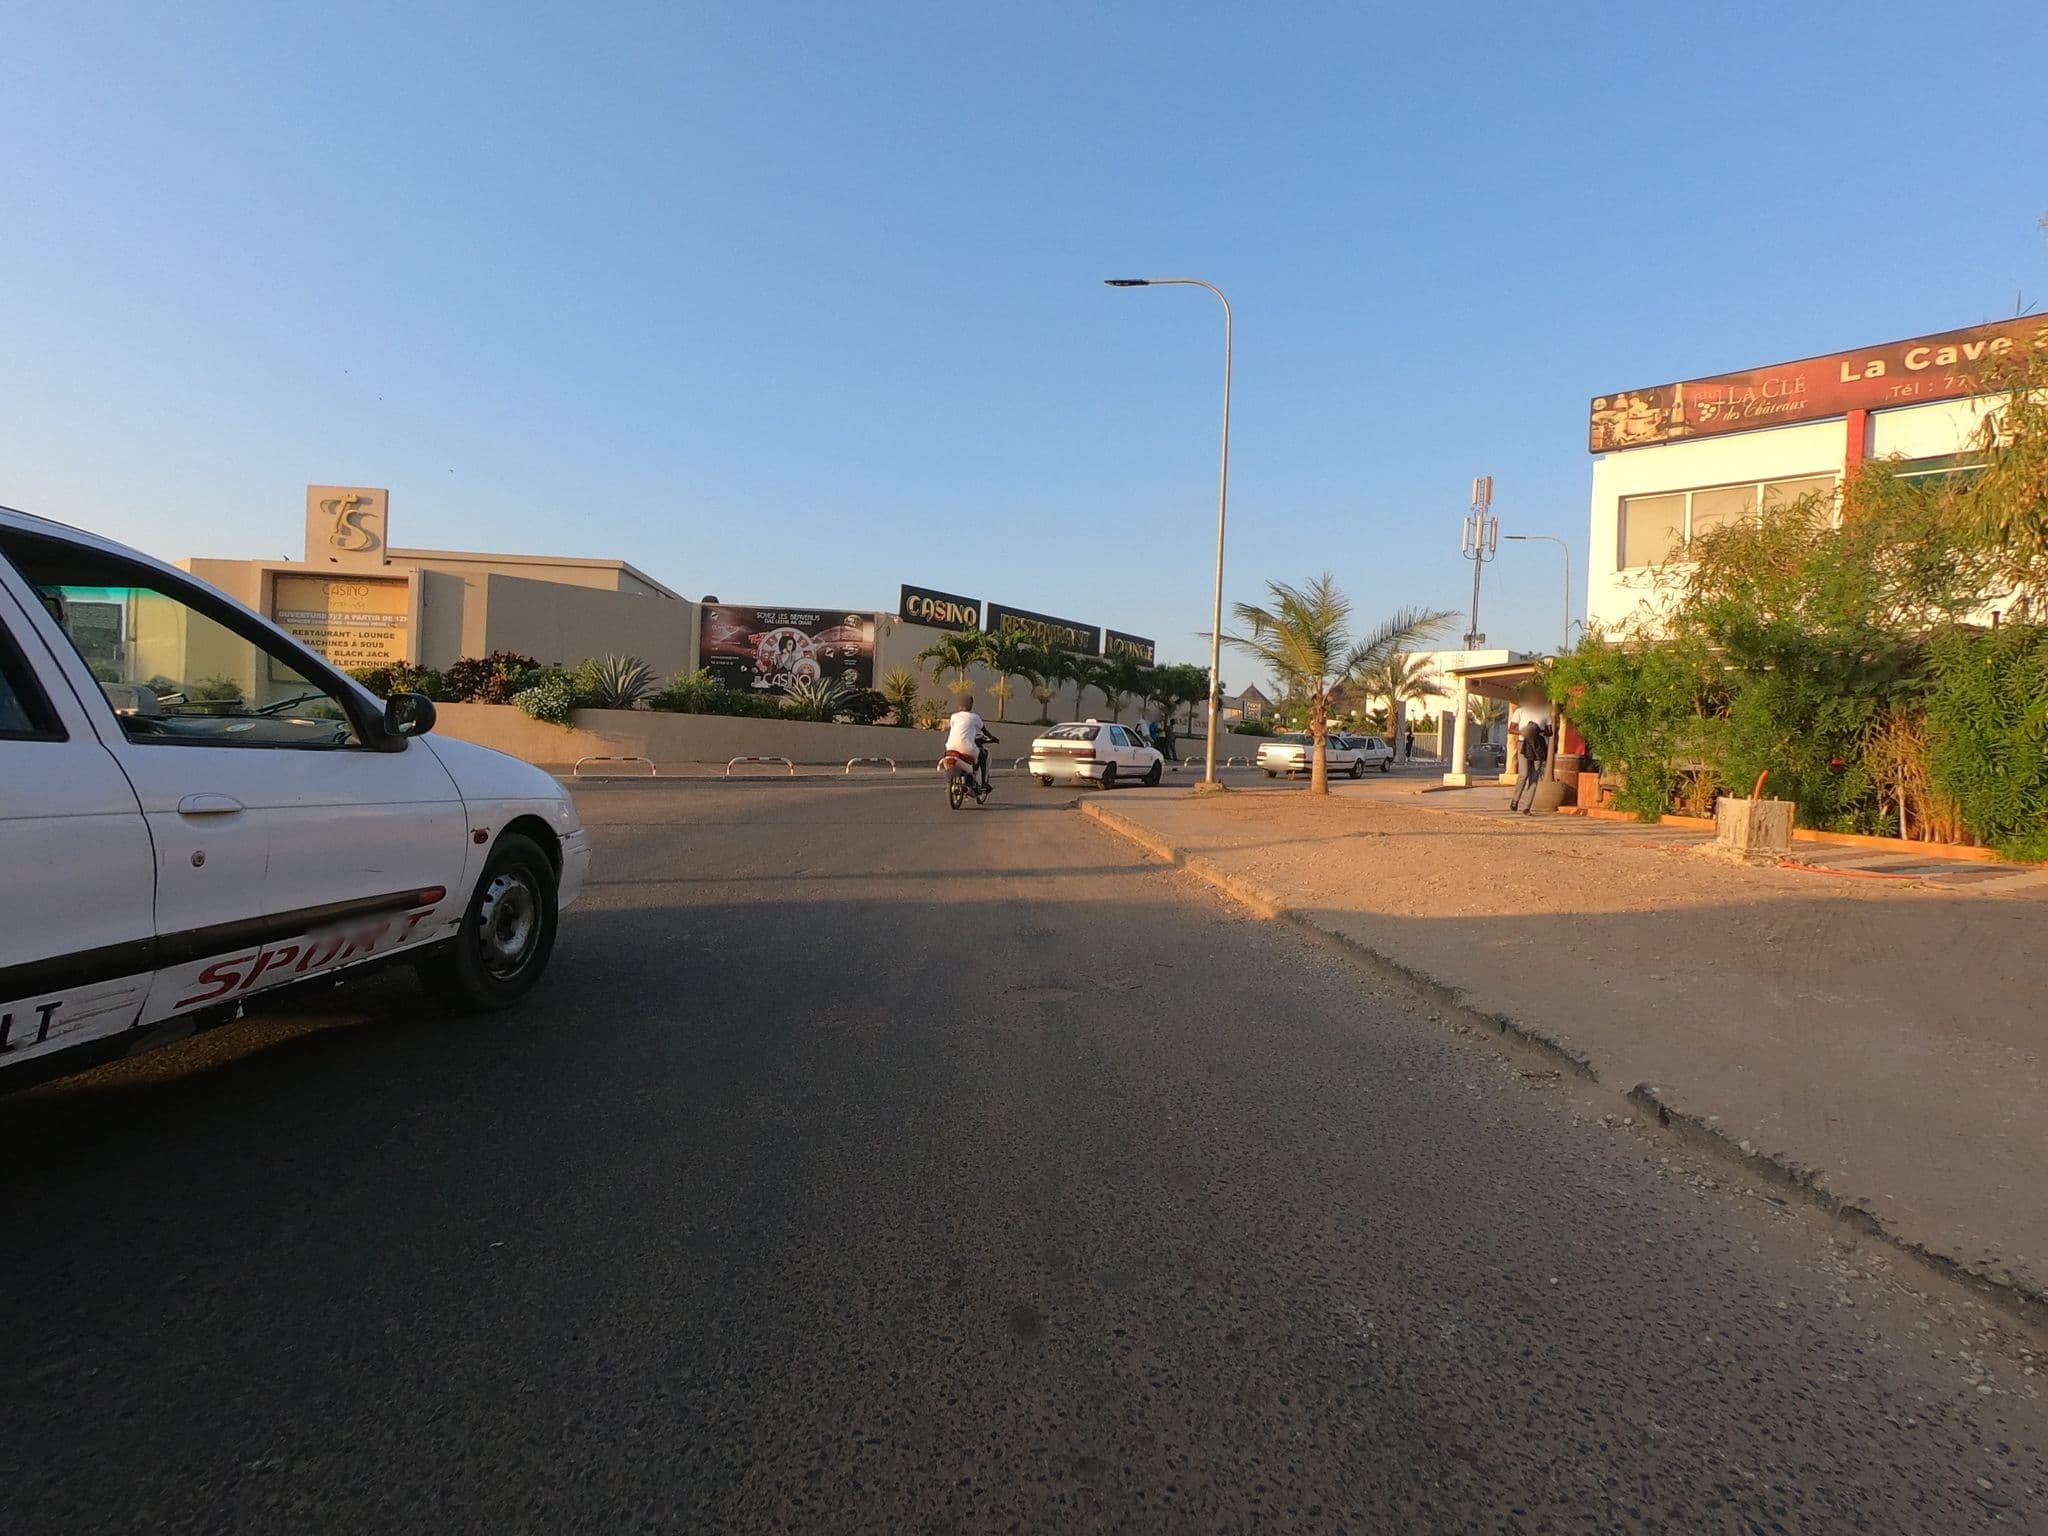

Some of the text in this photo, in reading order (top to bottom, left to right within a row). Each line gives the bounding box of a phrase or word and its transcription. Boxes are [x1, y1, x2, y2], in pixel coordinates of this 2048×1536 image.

[1840, 359, 1886, 383] La
[1904, 336, 2013, 371] Cave
[1728, 373, 1807, 405] LA CLÉ
[1890, 381, 1919, 397] Tél
[1723, 397, 1808, 421] des Châteaux
[322, 584, 369, 597] CASINO
[906, 595, 977, 627] CASINO
[292, 629, 395, 640] RESTAURANT LOUNGE
[1000, 613, 1092, 649] RESTAURANT
[1106, 634, 1154, 662] LOUNGE
[763, 672, 811, 689] CASINO
